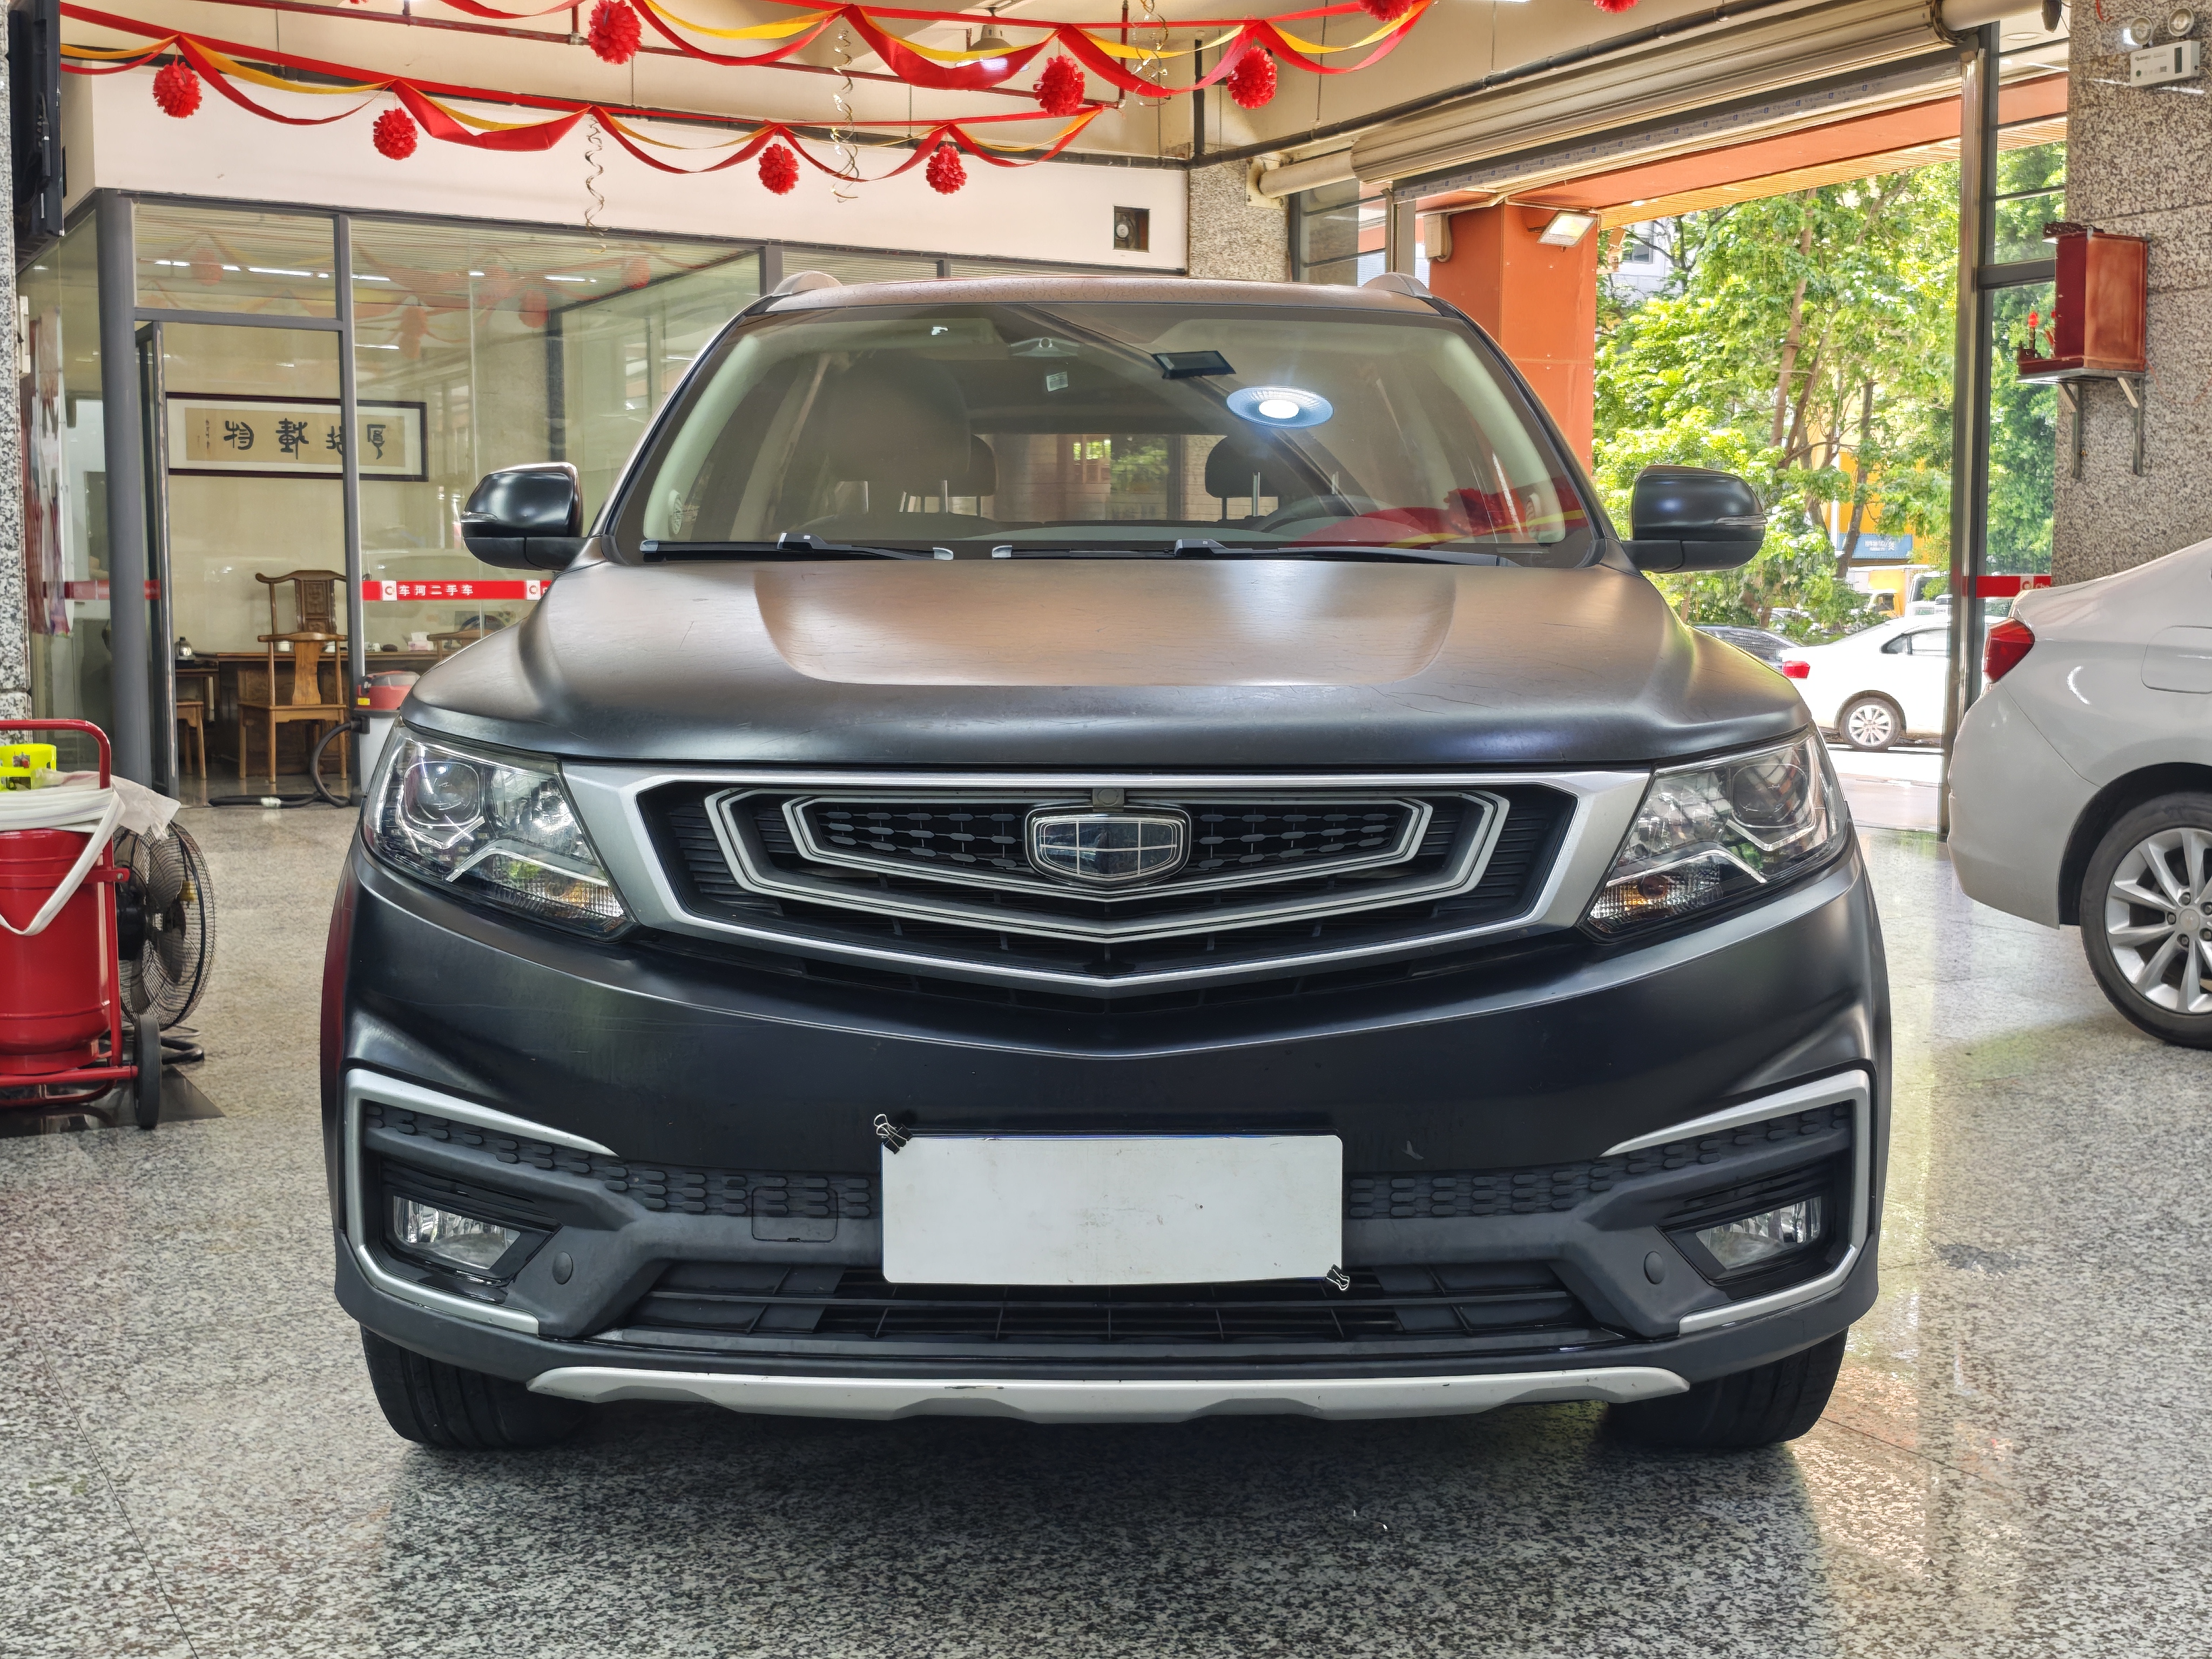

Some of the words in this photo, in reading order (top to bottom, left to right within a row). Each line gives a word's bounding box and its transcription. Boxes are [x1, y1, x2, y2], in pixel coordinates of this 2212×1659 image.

[399, 584, 474, 596] 车河二手车
